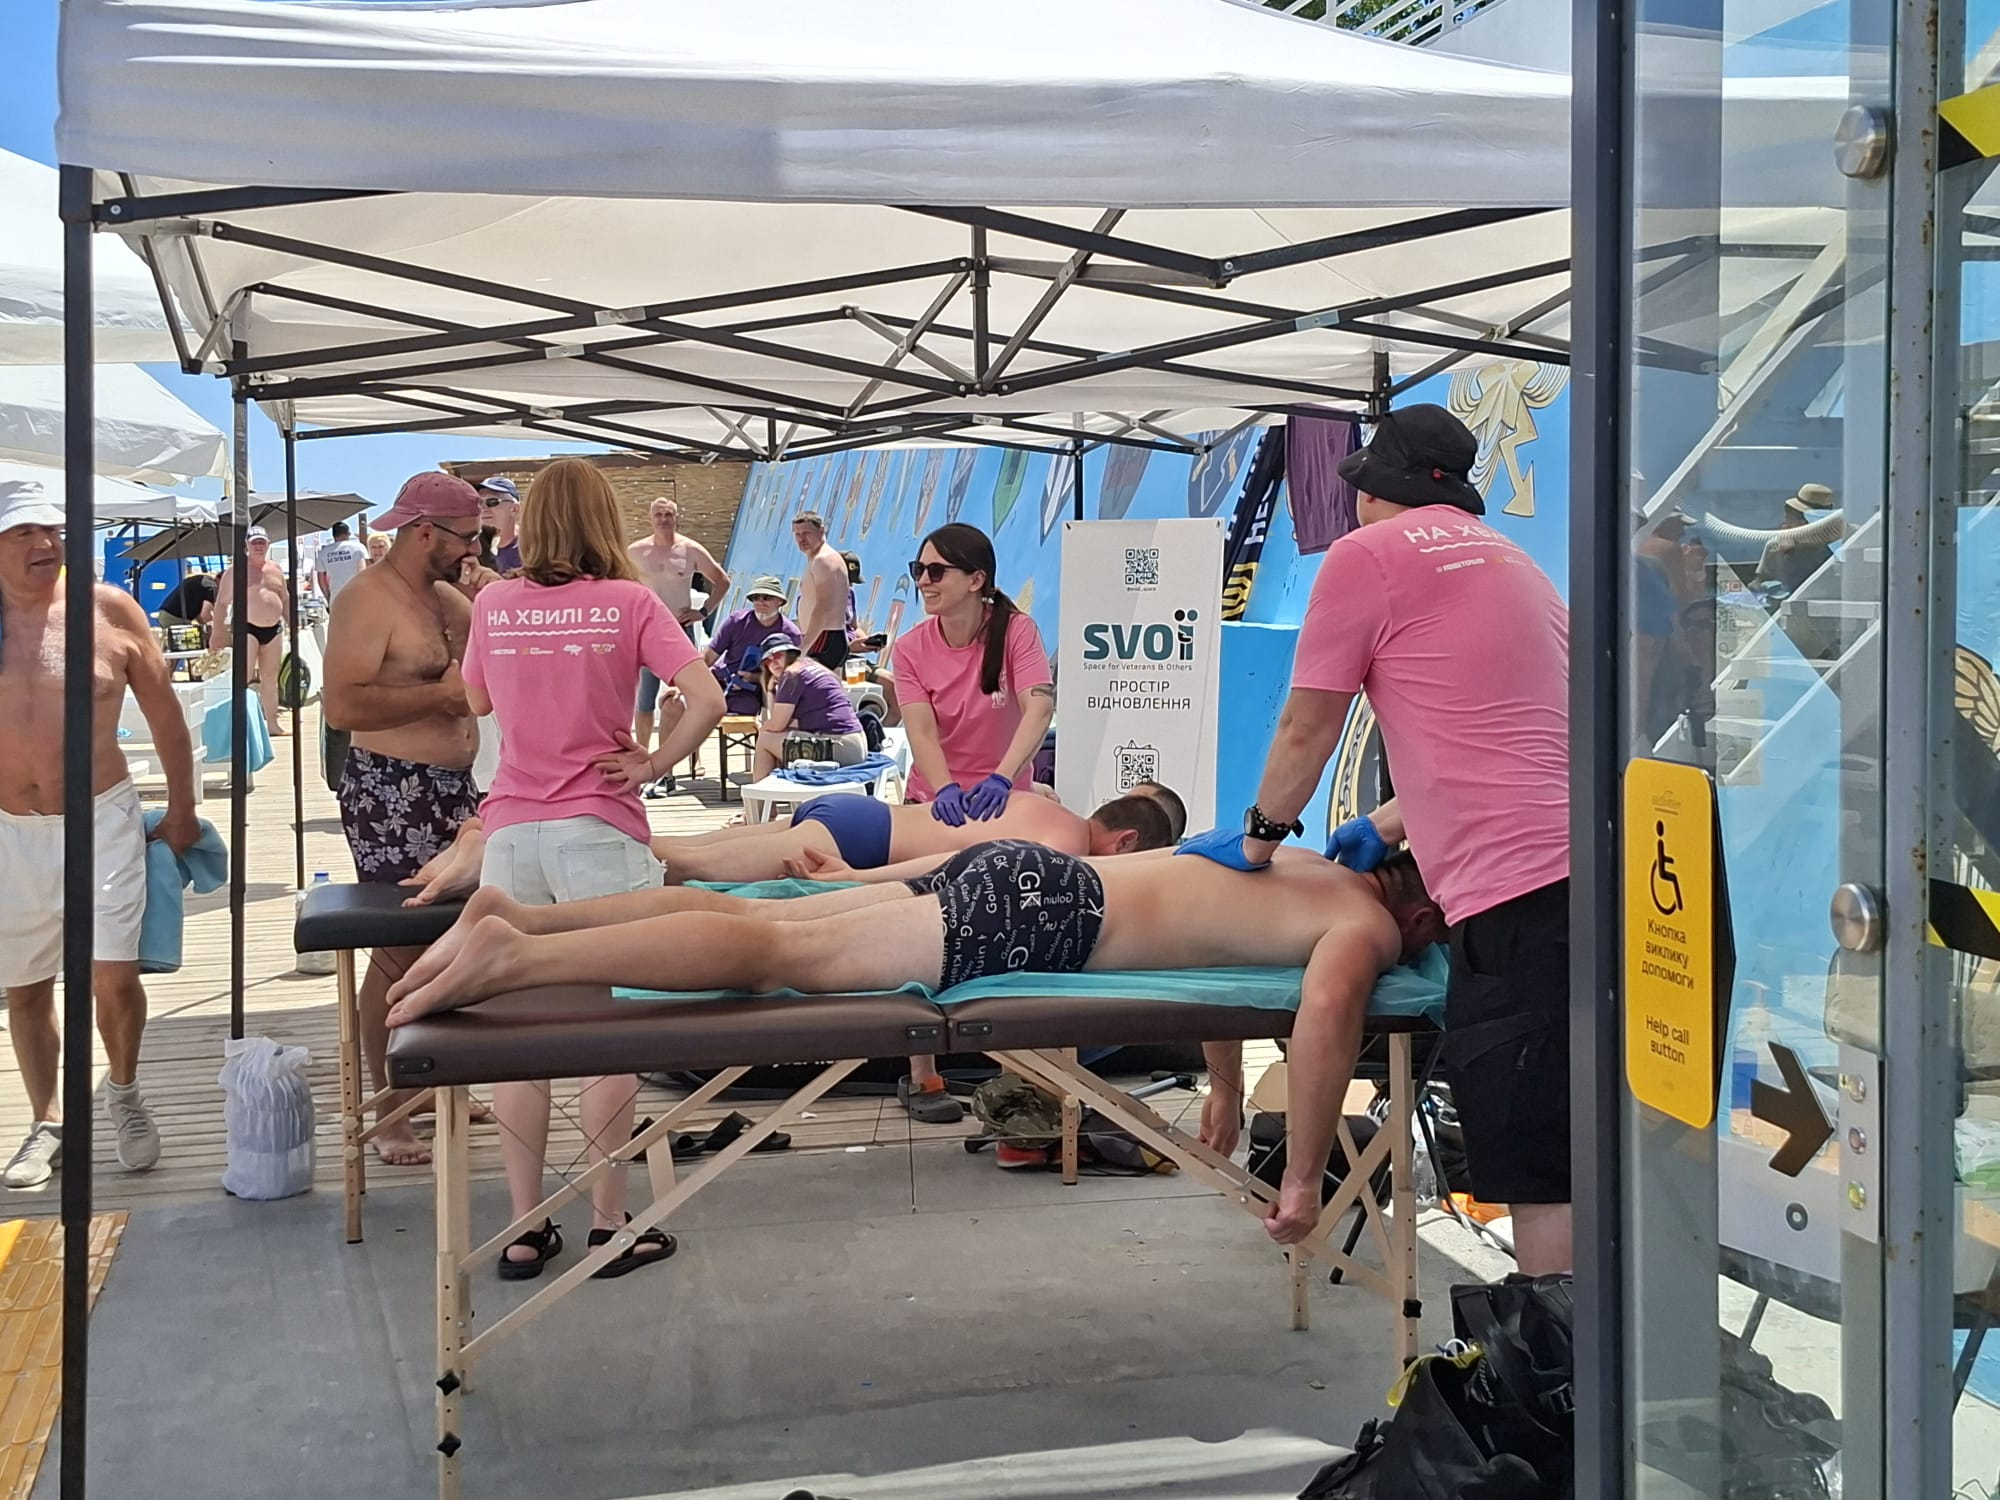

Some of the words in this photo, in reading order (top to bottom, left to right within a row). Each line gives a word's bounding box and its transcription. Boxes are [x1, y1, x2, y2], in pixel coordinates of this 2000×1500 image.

[1404, 526, 1452, 544] НА
[487, 610, 511, 627] НА
[515, 607, 583, 625] ХВИЛІ
[589, 606, 621, 623] 2.0
[1083, 662, 1106, 671] Space
[1108, 662, 1120, 671] for
[1121, 663, 1156, 671] Veterans
[1157, 663, 1164, 671] &
[1166, 663, 1193, 671] Others
[1109, 680, 1170, 693] ПРОСТІР
[1087, 696, 1191, 710] ВІДНОВЛЕННЯ
[993, 855, 1009, 870] GK
[983, 872, 998, 914] Goluin
[1018, 871, 1042, 911] GK
[1076, 872, 1086, 905] Goluin
[1647, 917, 1687, 945] Кнопка
[1008, 946, 1029, 969] G
[1645, 940, 1689, 970] виклику
[1641, 960, 1694, 991] допомоги
[1646, 1014, 1669, 1040] Help
[1671, 1027, 1689, 1046] call
